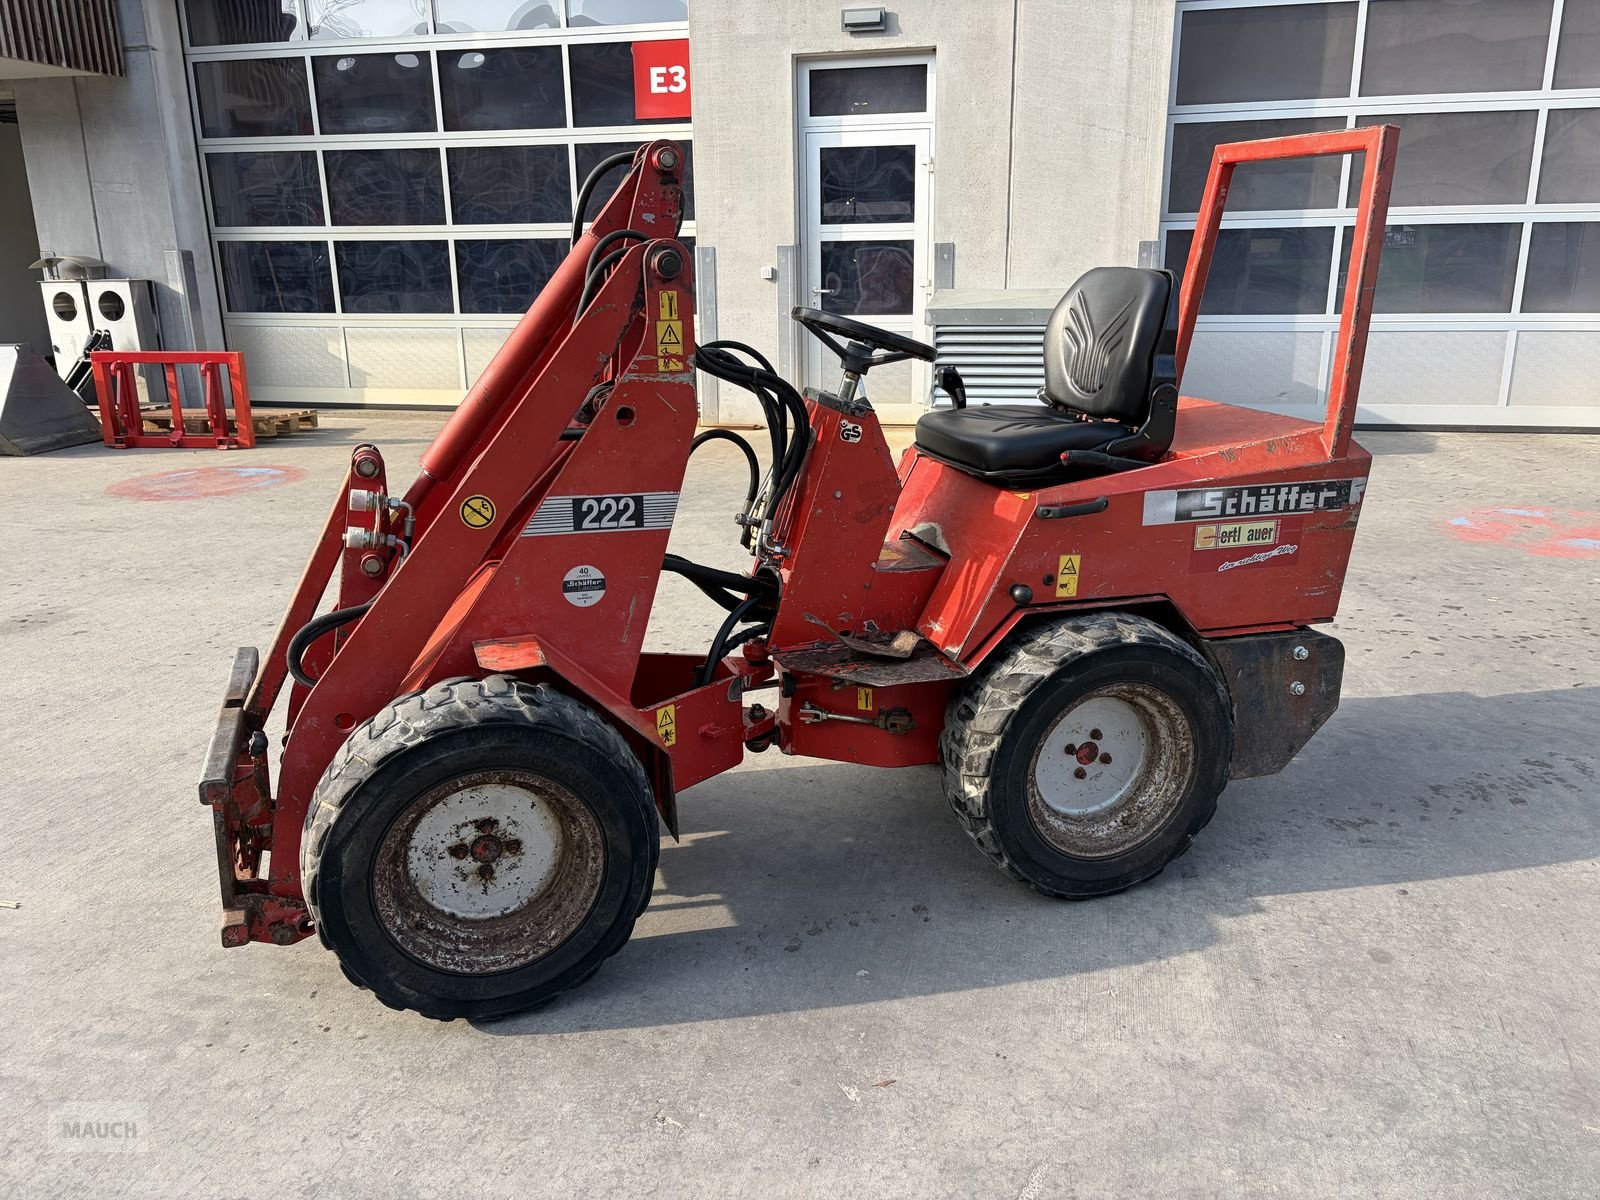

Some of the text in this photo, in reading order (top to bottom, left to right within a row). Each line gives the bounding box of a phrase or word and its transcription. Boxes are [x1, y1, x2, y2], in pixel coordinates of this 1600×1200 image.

[650, 65, 687, 93] E3
[841, 425, 861, 440] GS
[581, 497, 636, 529] 222
[1191, 486, 1337, 517] Schäffer
